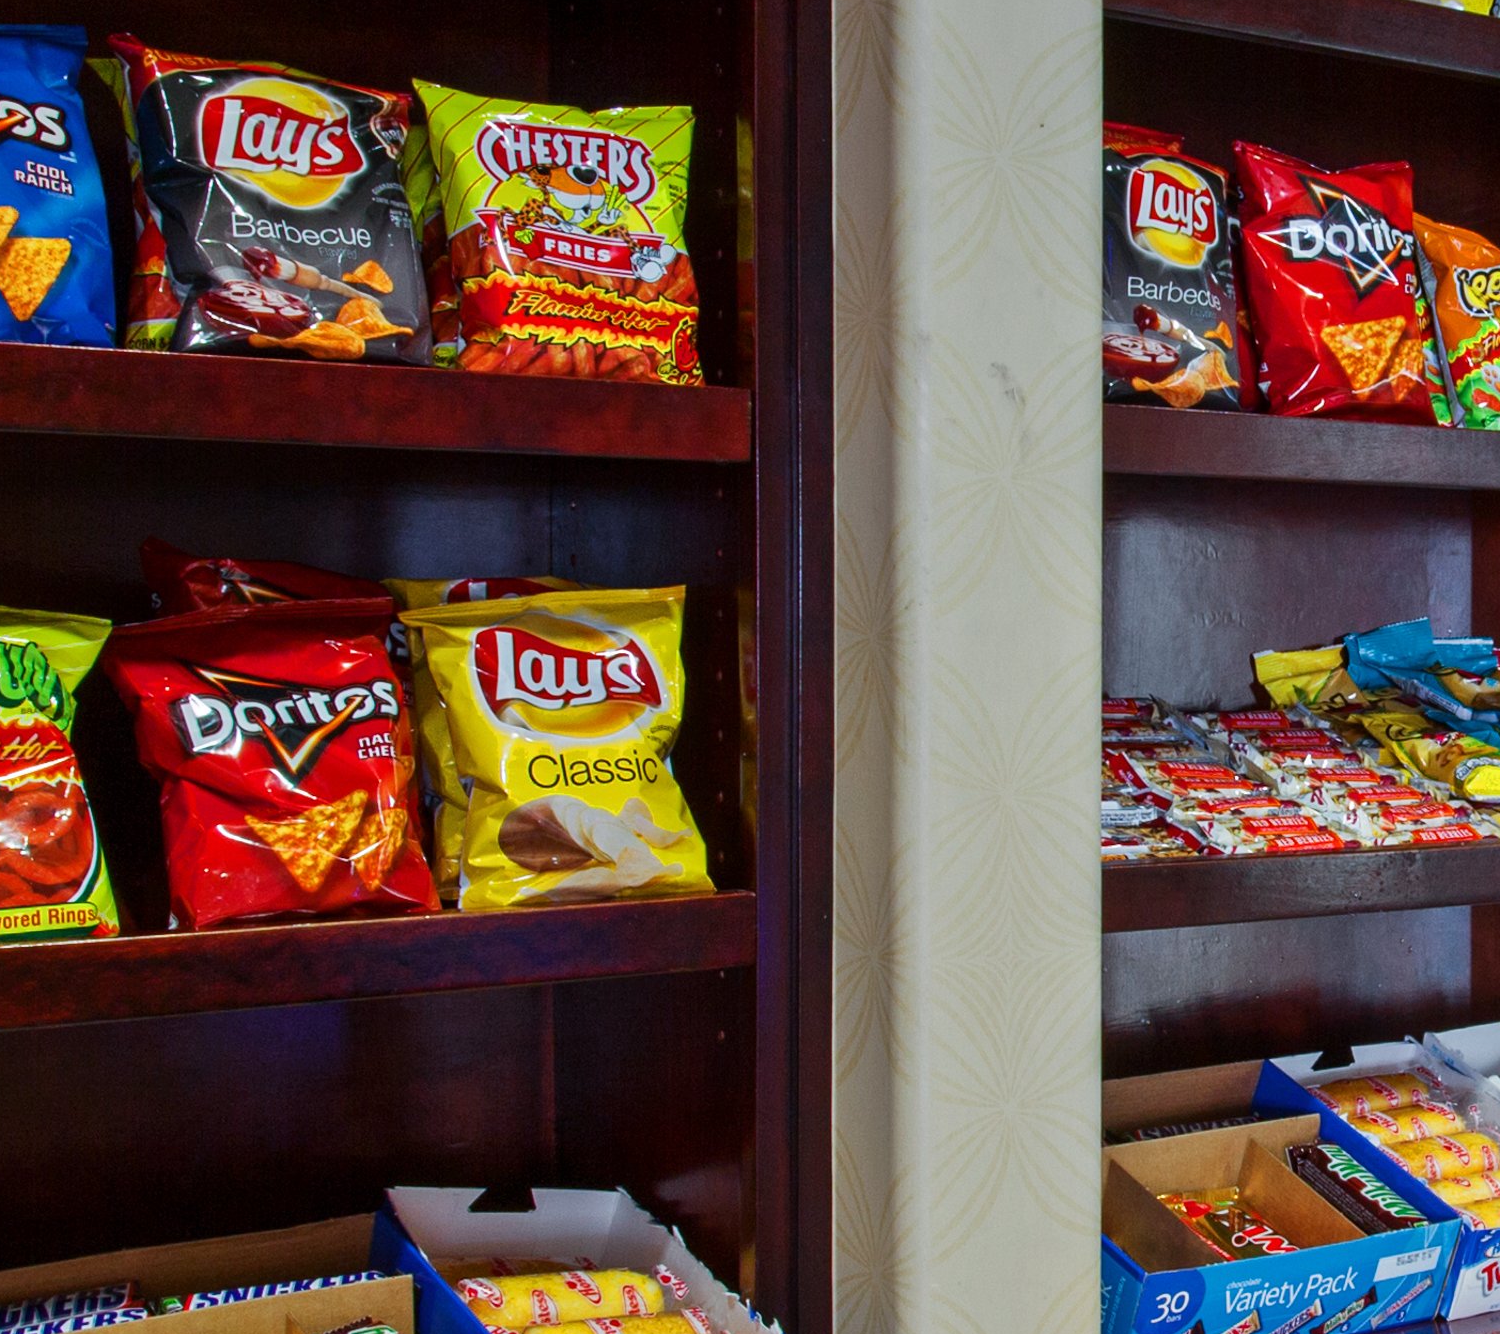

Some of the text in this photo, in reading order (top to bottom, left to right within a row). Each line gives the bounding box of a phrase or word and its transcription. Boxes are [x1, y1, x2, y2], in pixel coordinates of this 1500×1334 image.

[214, 98, 346, 175] Lay's
[26, 160, 70, 183] COOL
[480, 118, 653, 200] CHESTER'S
[14, 169, 74, 196] RANCH
[1135, 171, 1212, 235] Lay's
[230, 211, 372, 248] Barbecue
[1288, 218, 1414, 259] Doritos
[544, 238, 612, 264] FRIES
[510, 290, 669, 331] Flamin' Hot
[1126, 276, 1222, 312] Barbecue
[180, 680, 399, 754] Doritos
[527, 749, 659, 789] Classic
[1250, 816, 1309, 828] RED BERRIES
[1276, 833, 1334, 847] RED BERRIES
[1420, 828, 1474, 842] RED BERRIES
[46, 904, 98, 928] Rings
[1149, 1290, 1191, 1325] 30
[1224, 1266, 1356, 1314] Variety Pack
[1165, 1314, 1183, 1324] bars
